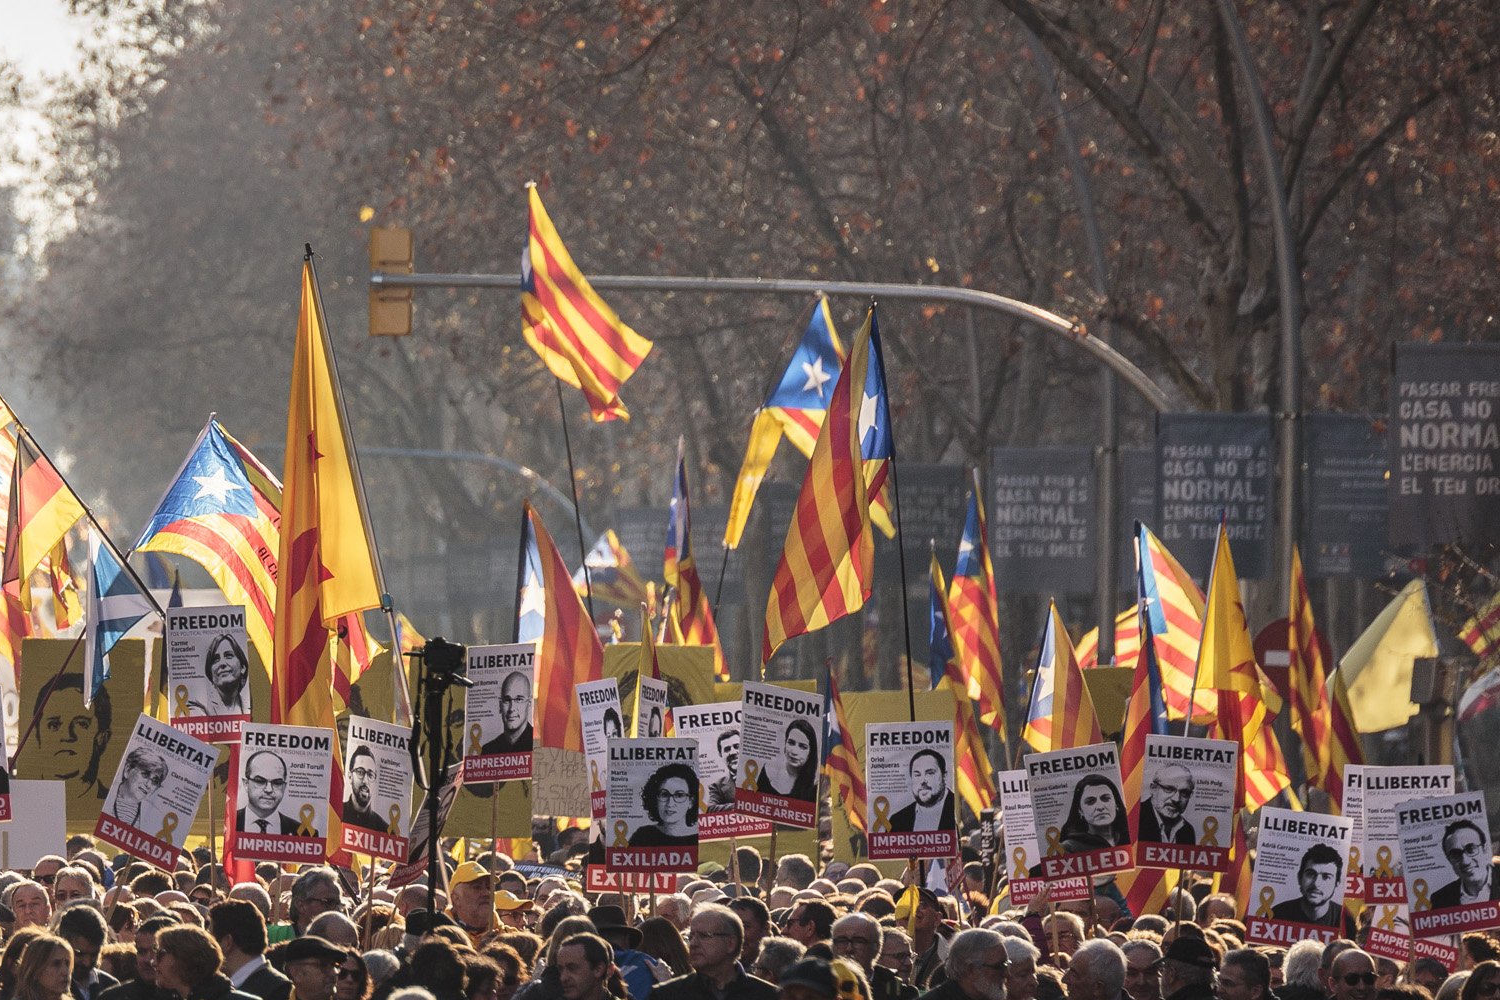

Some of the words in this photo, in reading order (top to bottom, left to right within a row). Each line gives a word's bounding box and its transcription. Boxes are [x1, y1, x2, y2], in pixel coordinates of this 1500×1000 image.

[1400, 382, 1461, 397] PASSAR
[1400, 401, 1453, 419] CASA
[1462, 400, 1492, 418] NO
[1401, 422, 1500, 449] NORMA
[1164, 446, 1212, 458] PASSAR
[1164, 460, 1205, 477] CASA
[1215, 461, 1237, 476] NO
[1401, 478, 1422, 494] EL
[1432, 477, 1467, 495] TEU
[1164, 523, 1182, 539] EL
[171, 614, 243, 630] FREEDOM
[470, 653, 534, 669] LLIBERTAT
[580, 687, 617, 705] FREEDOM
[642, 685, 665, 703] FREEDOM
[746, 691, 820, 717] FREEDOM
[763, 716, 783, 725] Carrasco
[137, 724, 214, 768] LLIBERTAT
[246, 732, 329, 750] FREEDOM
[871, 730, 949, 746] FREEDOM
[466, 755, 530, 769] EMPRESONAT
[611, 748, 695, 760] LLIBERTAT
[1149, 745, 1234, 763] LLIBERTAT
[1030, 751, 1115, 775] FREEDOM
[171, 772, 183, 781] Clara
[1367, 776, 1450, 789] LLIBERTAT
[762, 796, 788, 807] UNDER
[738, 800, 771, 816] HOUSE
[774, 808, 813, 823] ARREST
[1399, 800, 1482, 825] FREEDOM
[1264, 817, 1348, 839] LLIBERTAT
[101, 821, 173, 864] EXILIADA
[238, 838, 322, 855] IMPRISONED
[344, 828, 404, 858] EXILIAT
[874, 834, 950, 846] IMPRISONED
[1277, 844, 1300, 852] Carrasco
[1404, 836, 1420, 845] Josep
[612, 853, 692, 866] EXILIADA
[1046, 850, 1129, 877] EXILED
[1146, 847, 1221, 866] EXILIAT
[592, 869, 672, 889] EXILIAT
[1374, 883, 1403, 898] EXI
[1415, 906, 1498, 930] IMPRISONED
